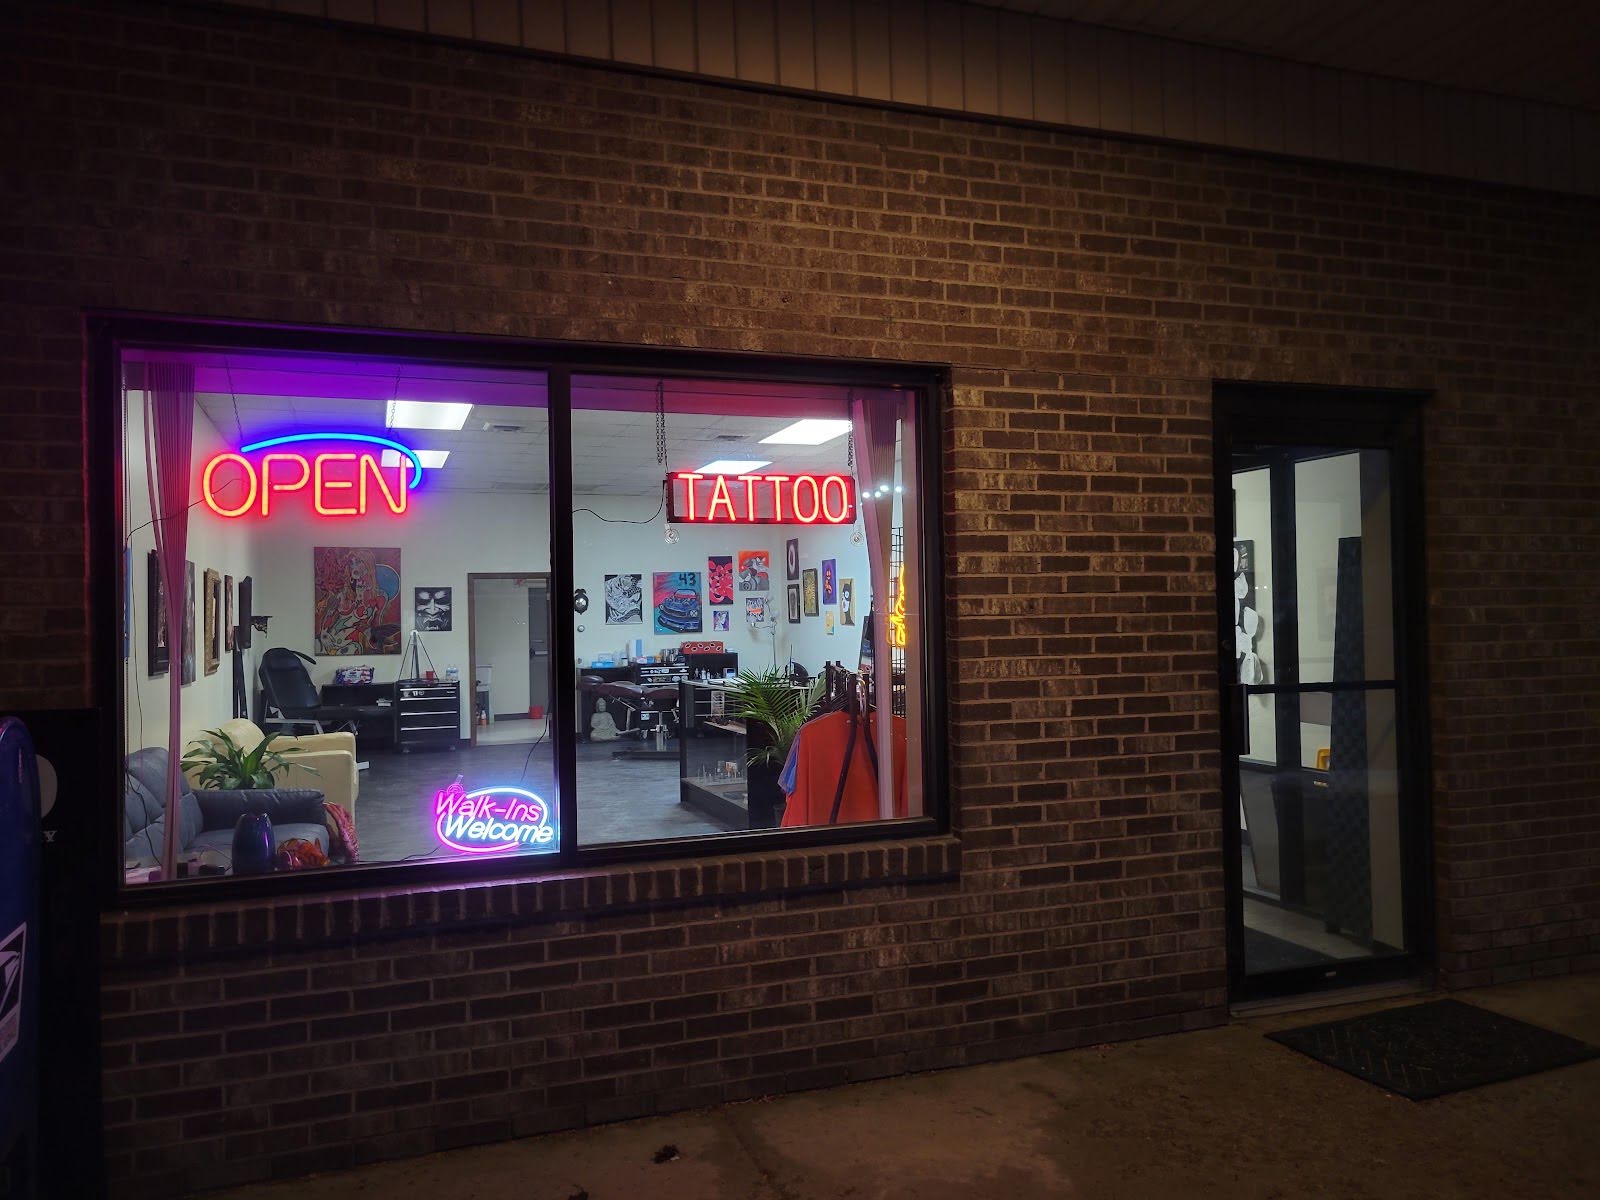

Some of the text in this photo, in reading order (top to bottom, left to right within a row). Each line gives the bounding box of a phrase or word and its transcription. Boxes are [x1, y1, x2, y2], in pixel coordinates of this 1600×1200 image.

[202, 452, 408, 518] OPEN
[677, 472, 848, 524] TATTOO
[679, 572, 697, 587] 43
[436, 791, 543, 823] Walk-Ins
[444, 814, 555, 844] Welcome
